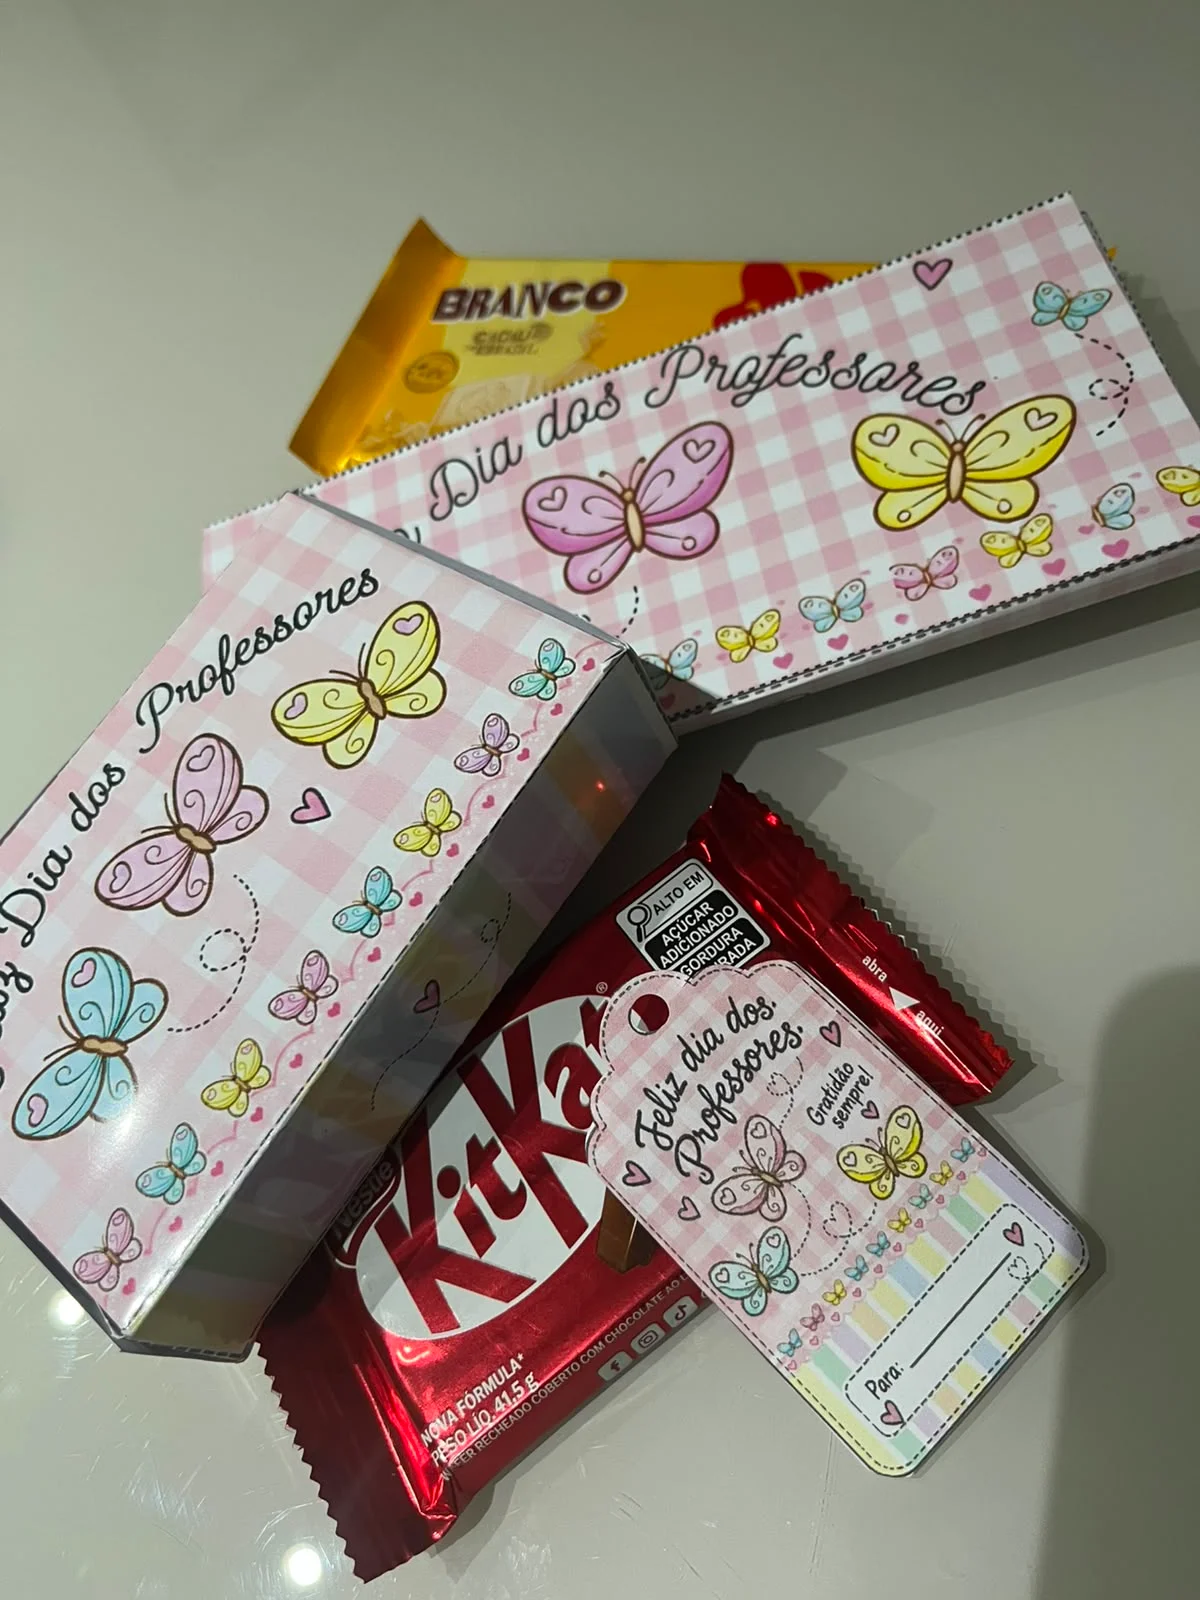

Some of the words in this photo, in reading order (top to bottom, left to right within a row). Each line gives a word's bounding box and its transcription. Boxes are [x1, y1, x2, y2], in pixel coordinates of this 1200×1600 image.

[433, 279, 625, 323] BRANCO
[430, 436, 522, 521] Dia
[537, 382, 621, 448] dos
[644, 333, 986, 415] Professores
[69, 763, 126, 832] dos
[136, 568, 380, 754] Professores
[653, 887, 685, 916] ALTO
[683, 871, 705, 891] EM
[659, 905, 735, 968] ADICIONADO
[661, 901, 714, 947] AÇÚCAR
[680, 927, 744, 976] GORDURA
[714, 938, 757, 966] RADA
[862, 955, 888, 983] abra
[635, 1072, 688, 1151] Feliz
[677, 1028, 725, 1072] dia
[806, 1061, 854, 1126] Gratidão
[831, 1064, 875, 1130] sempre!
[474, 1402, 532, 1451] RECHEADO
[531, 1361, 581, 1405] COBERTO
[580, 1340, 606, 1365] COM
[604, 1291, 665, 1344] CHOCOLATE
[665, 1279, 680, 1296] AO
[864, 1361, 905, 1400] Para:
[420, 1409, 459, 1448] NOVA
[431, 1429, 467, 1467] PESO
[525, 1371, 540, 1393] g
